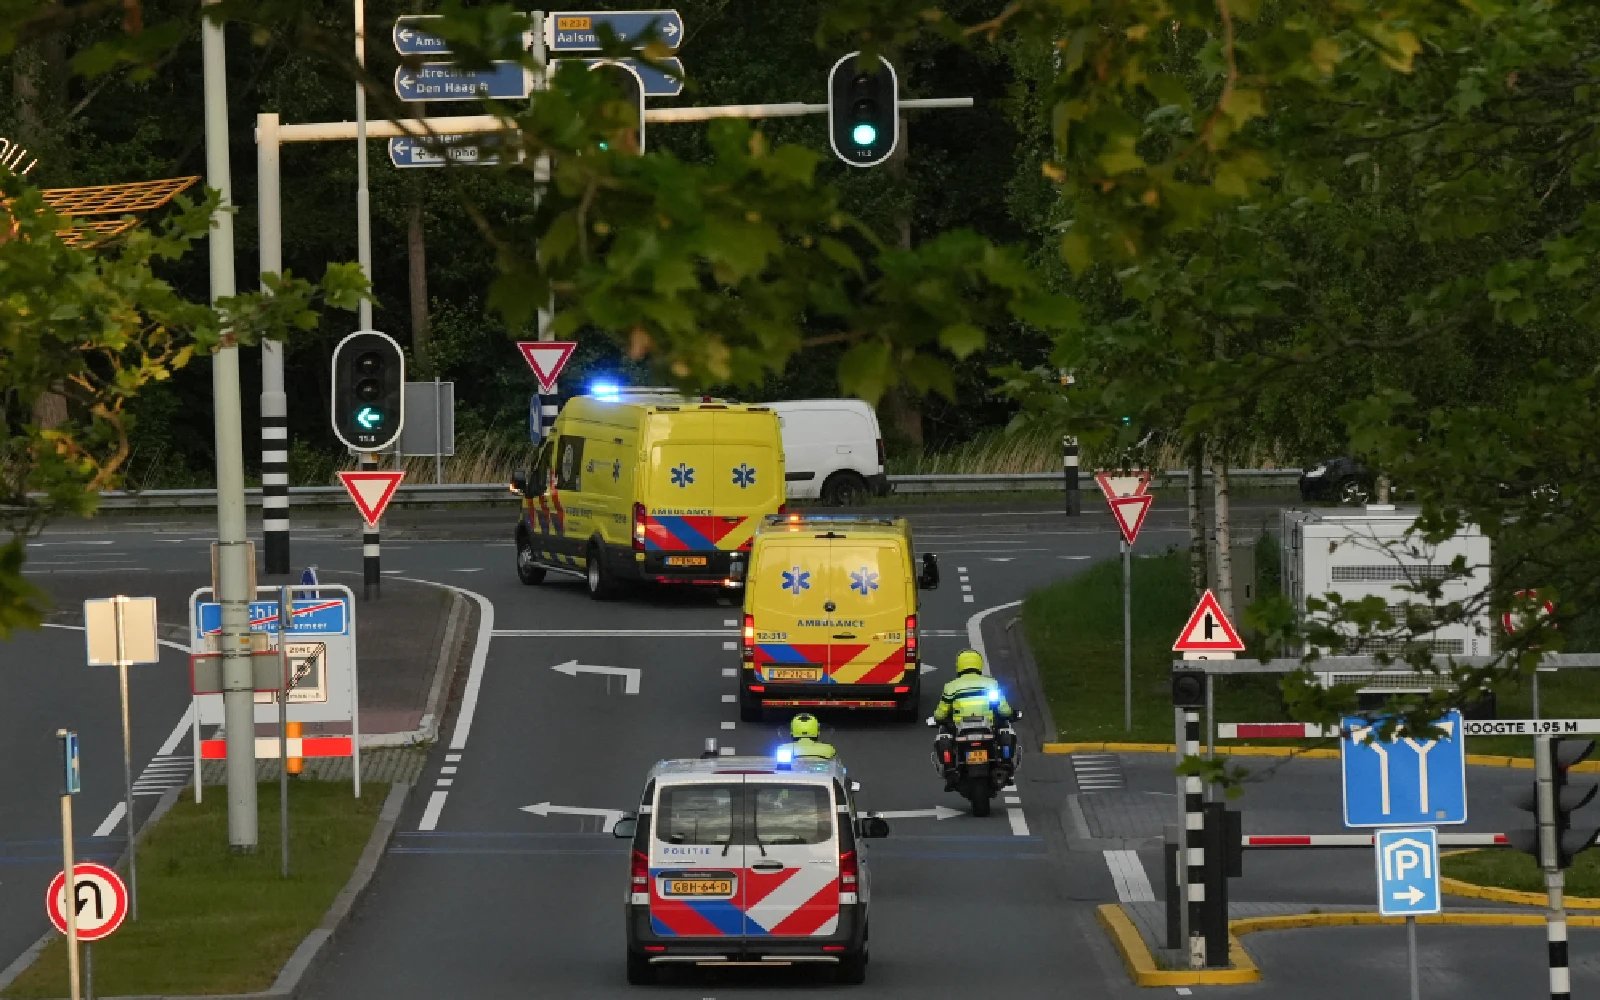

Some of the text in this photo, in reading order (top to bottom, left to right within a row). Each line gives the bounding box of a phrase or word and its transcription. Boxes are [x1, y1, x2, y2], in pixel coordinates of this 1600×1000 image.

[560, 18, 587, 27] N 232
[557, 32, 602, 43] Aalsm
[416, 83, 476, 94] Den Haag
[651, 508, 712, 516] AMBULANCE
[797, 619, 865, 628] AMBULANCE
[289, 646, 311, 654] ZONE
[1533, 722, 1560, 732] 1.95
[1565, 722, 1577, 731] M
[663, 847, 711, 855] POLITIE
[673, 882, 728, 893] GBH-64-D
